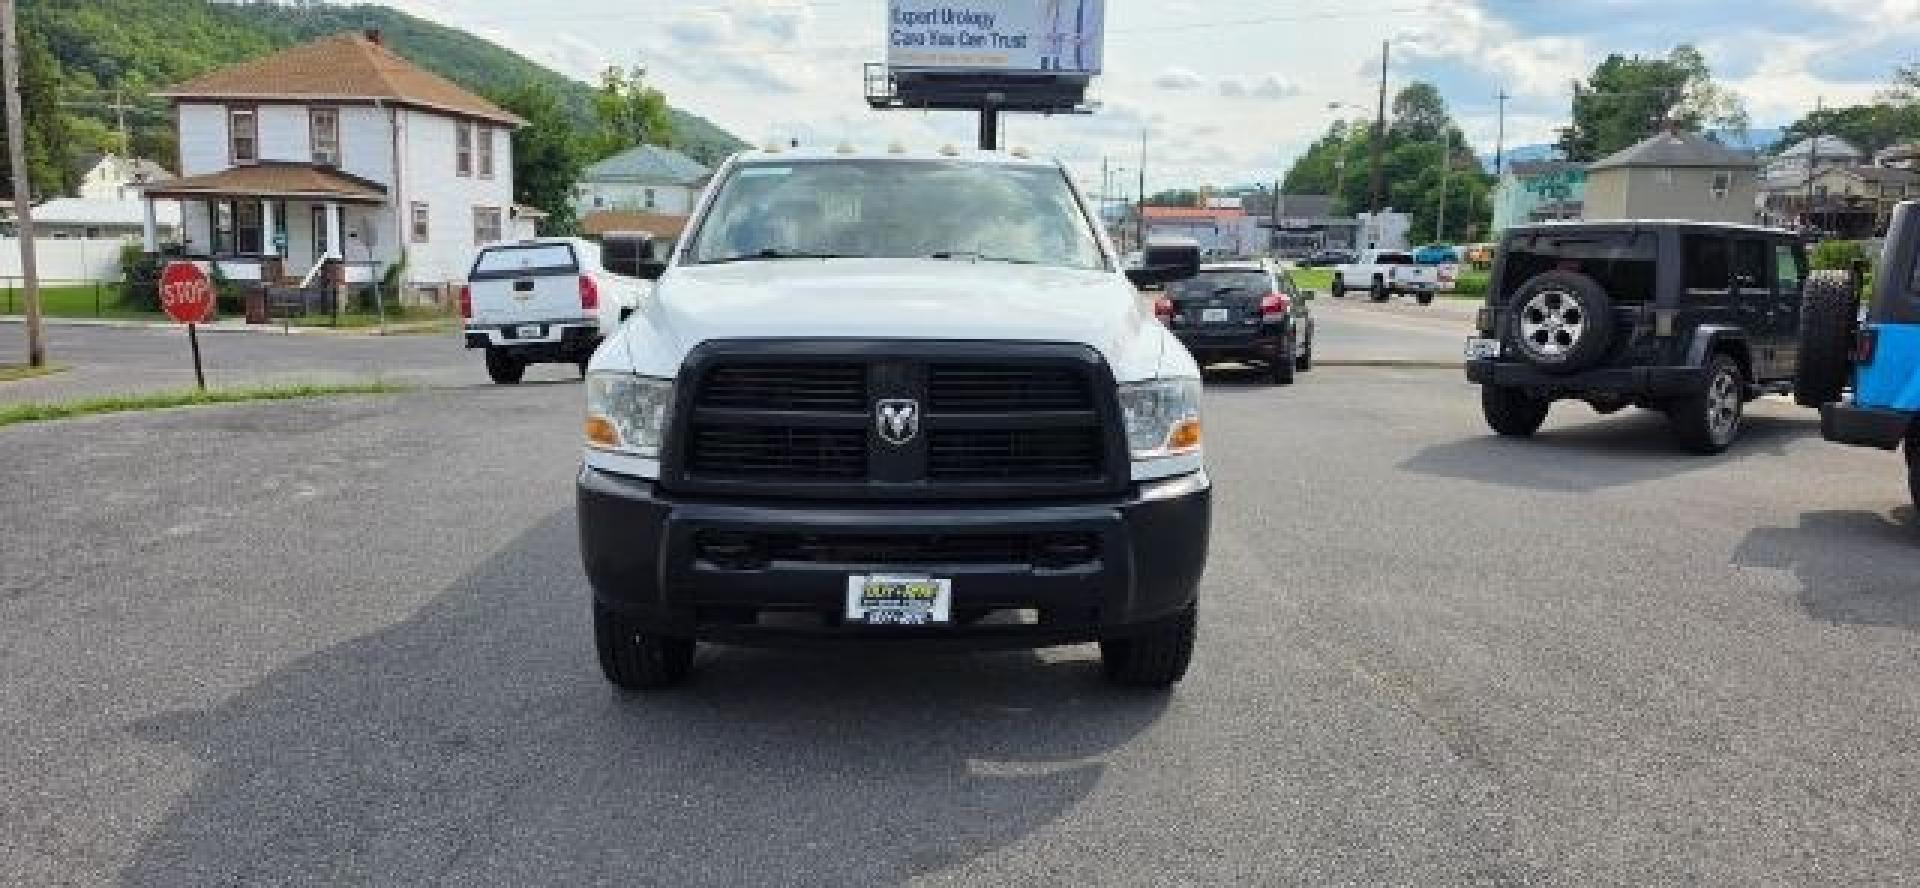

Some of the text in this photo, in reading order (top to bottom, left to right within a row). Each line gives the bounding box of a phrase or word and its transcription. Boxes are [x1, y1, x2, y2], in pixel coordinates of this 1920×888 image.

[941, 8, 995, 30] Urology
[929, 30, 955, 46] You
[989, 32, 1027, 49] Trust
[164, 279, 208, 305] STOP
